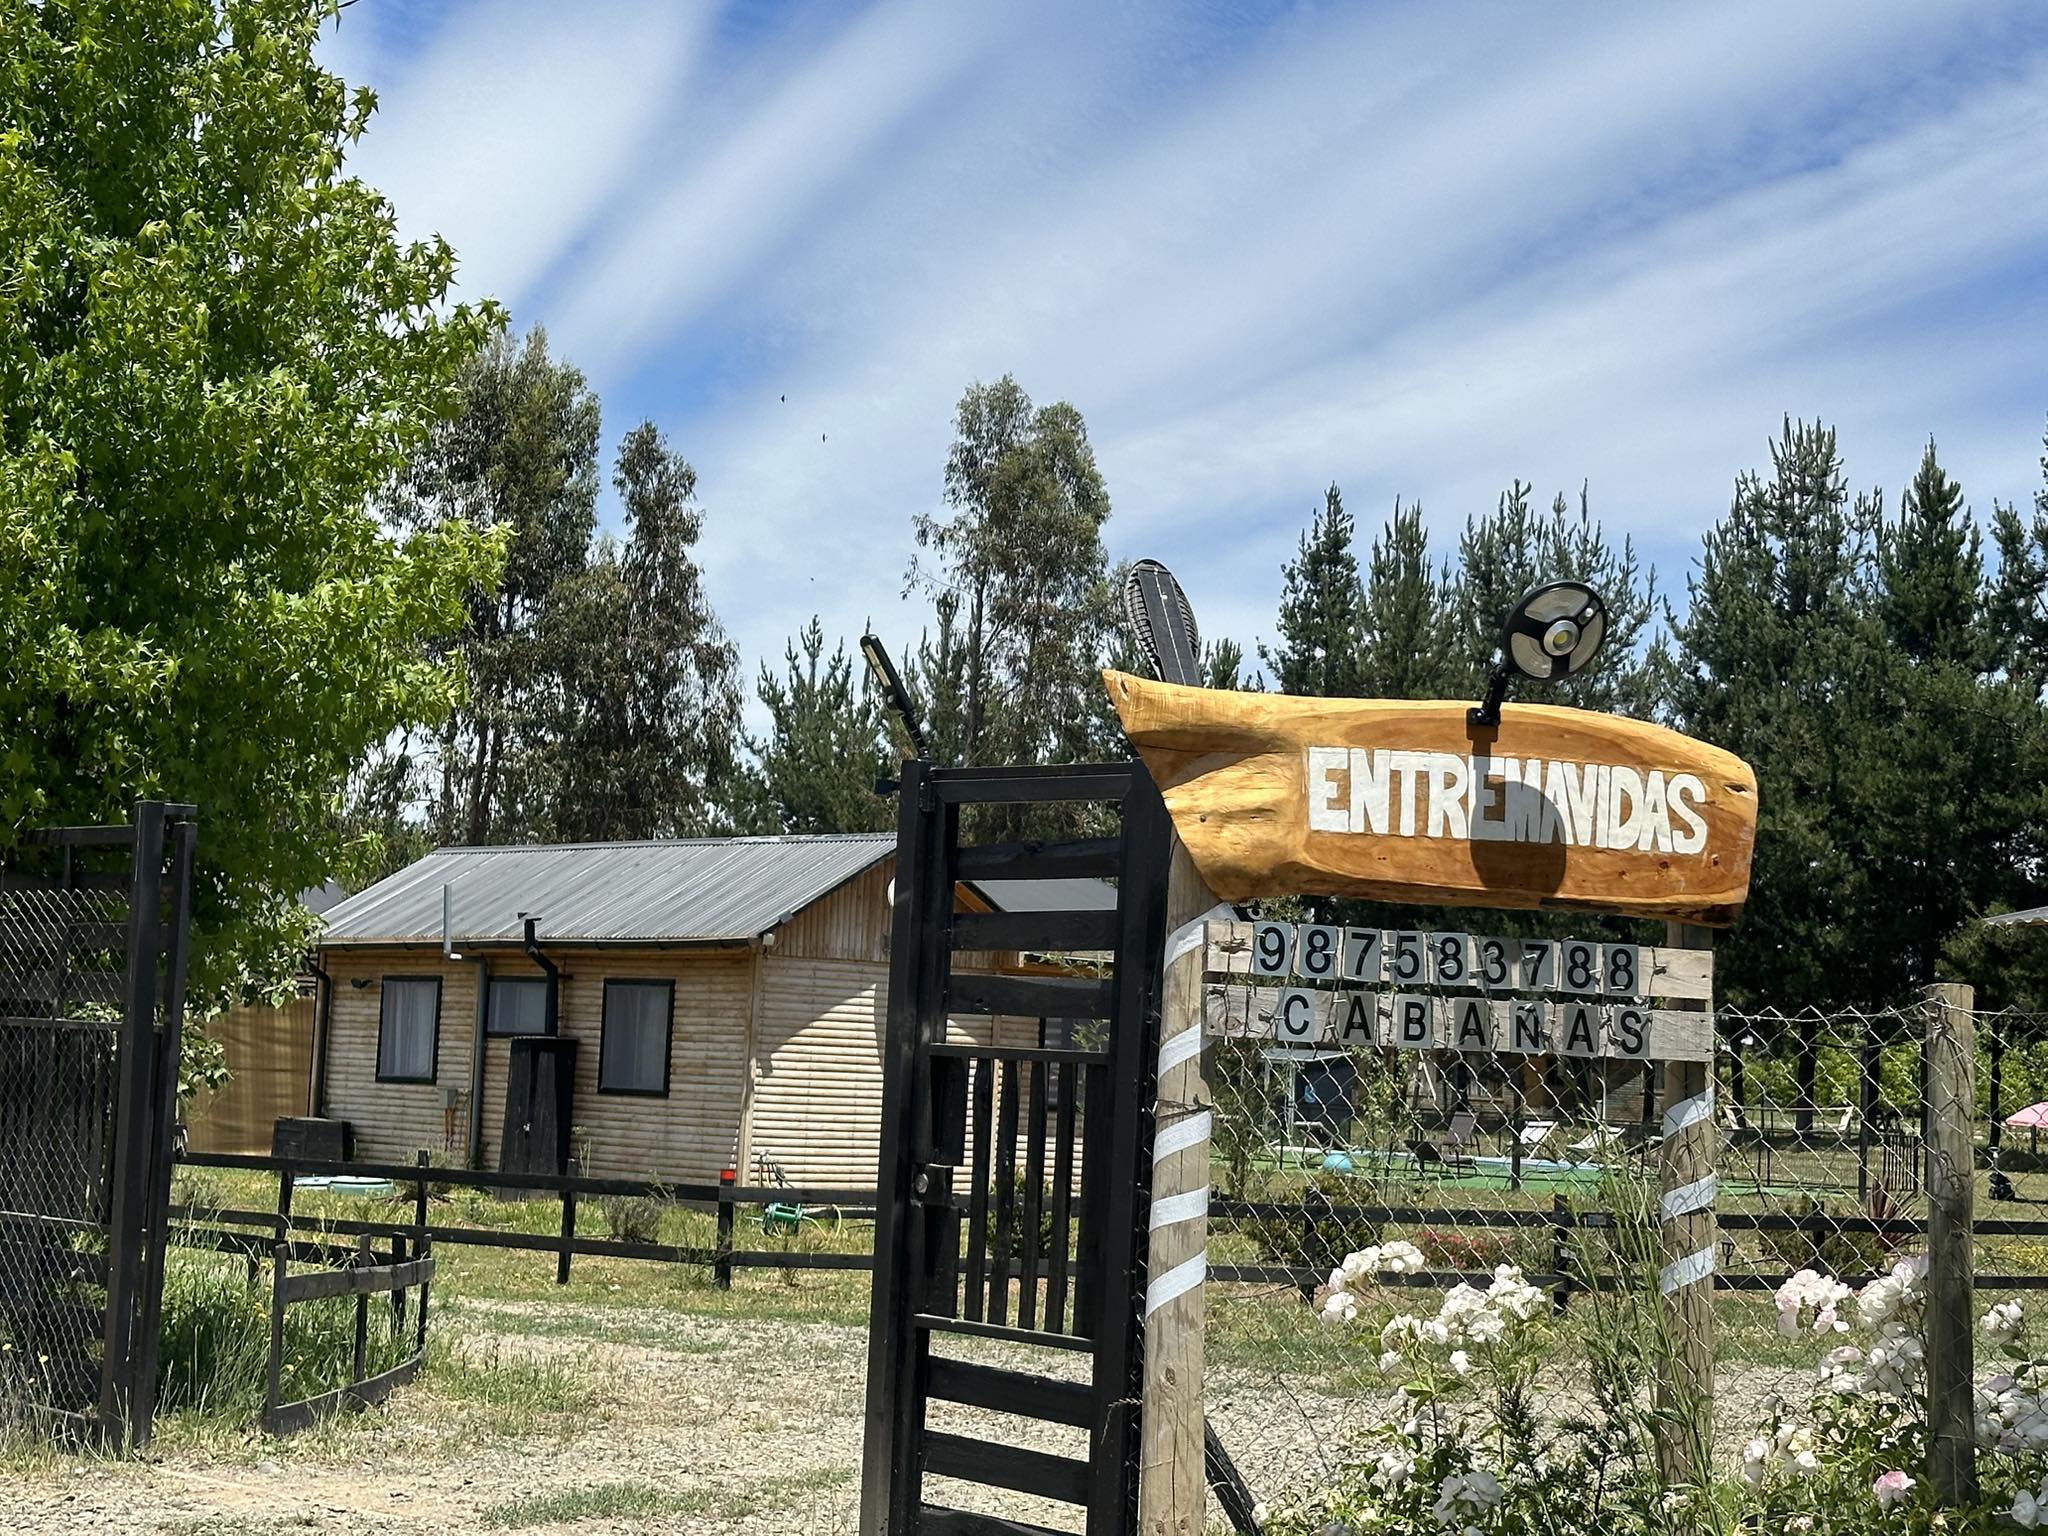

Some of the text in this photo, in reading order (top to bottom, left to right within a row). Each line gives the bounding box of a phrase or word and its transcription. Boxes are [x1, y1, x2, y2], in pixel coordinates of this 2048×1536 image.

[1308, 746, 1709, 854] ENTREMAVIDAS
[1258, 926, 1634, 991] 987583788
[1283, 994, 1644, 1055] CABAÑAS
